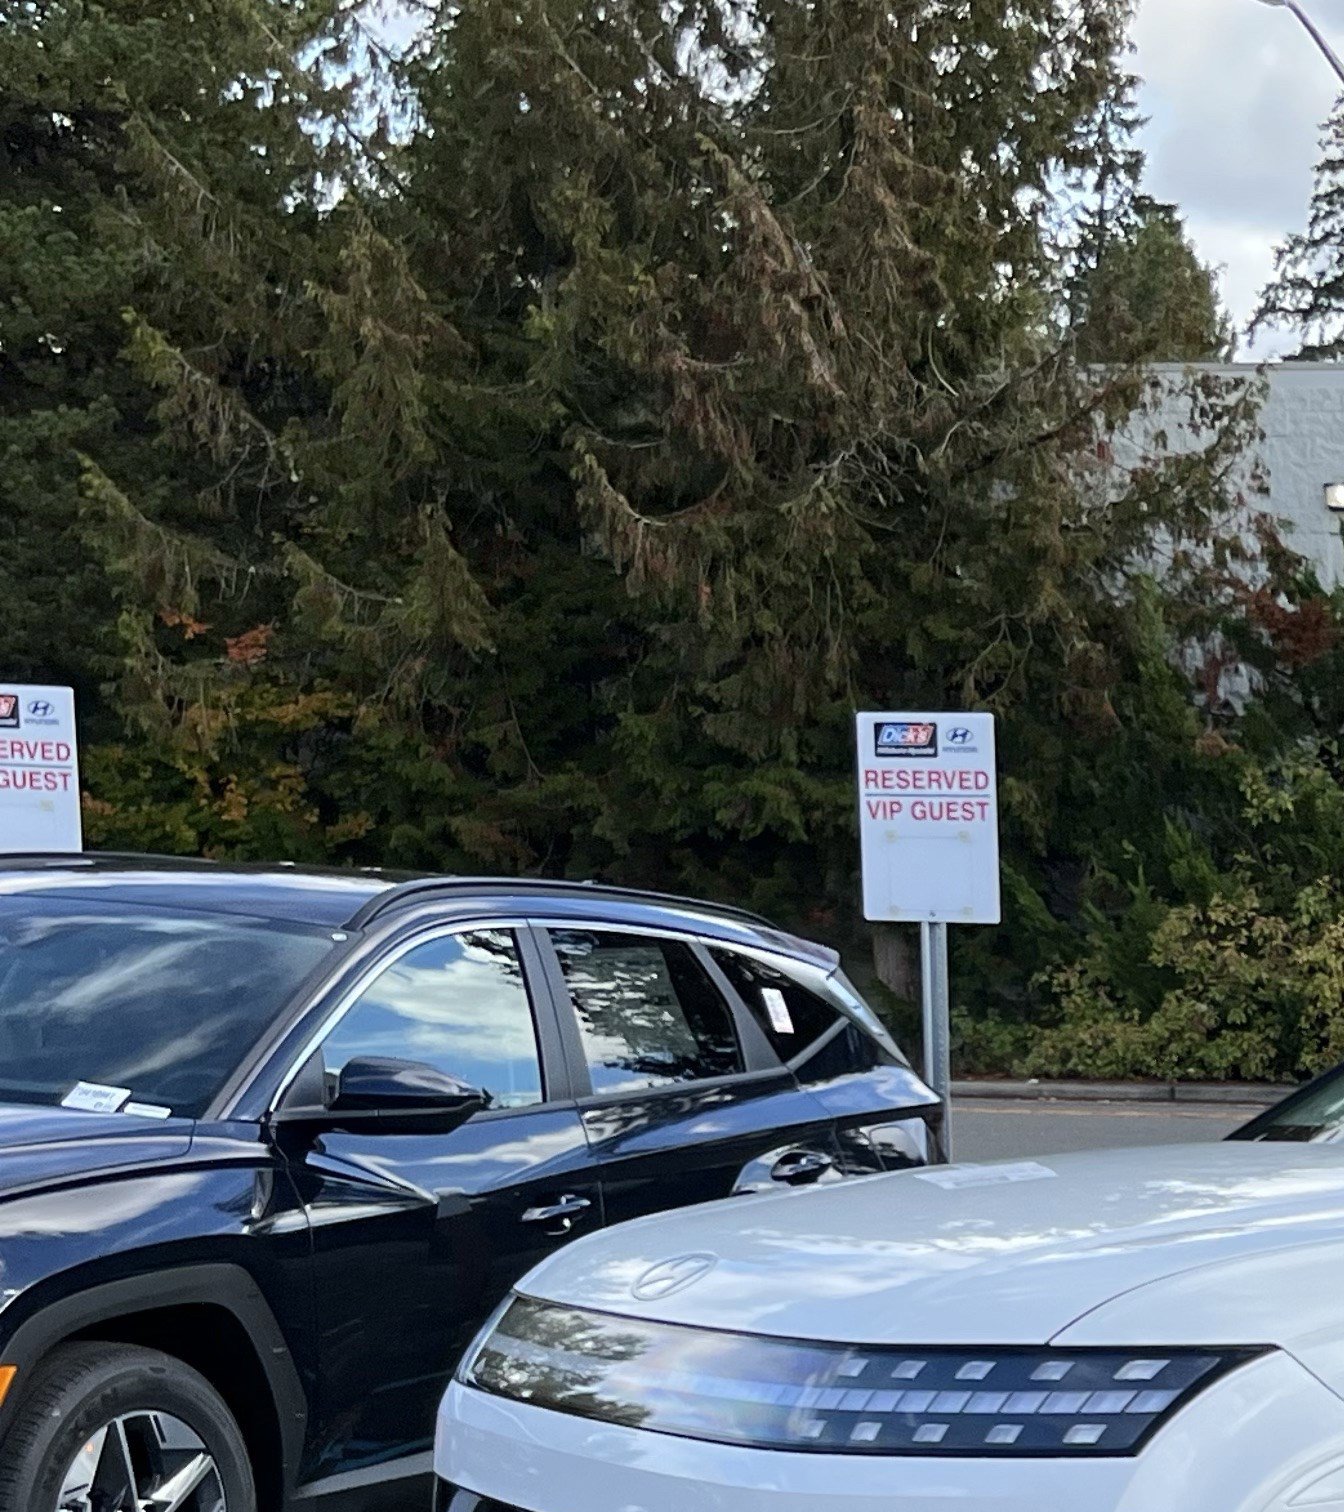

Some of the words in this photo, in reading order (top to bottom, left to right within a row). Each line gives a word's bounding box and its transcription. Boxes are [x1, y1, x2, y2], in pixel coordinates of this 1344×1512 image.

[0, 770, 71, 791] GUEST
[864, 769, 989, 790] RESERVED
[866, 800, 903, 820] VIP
[911, 801, 990, 821] GUEST
